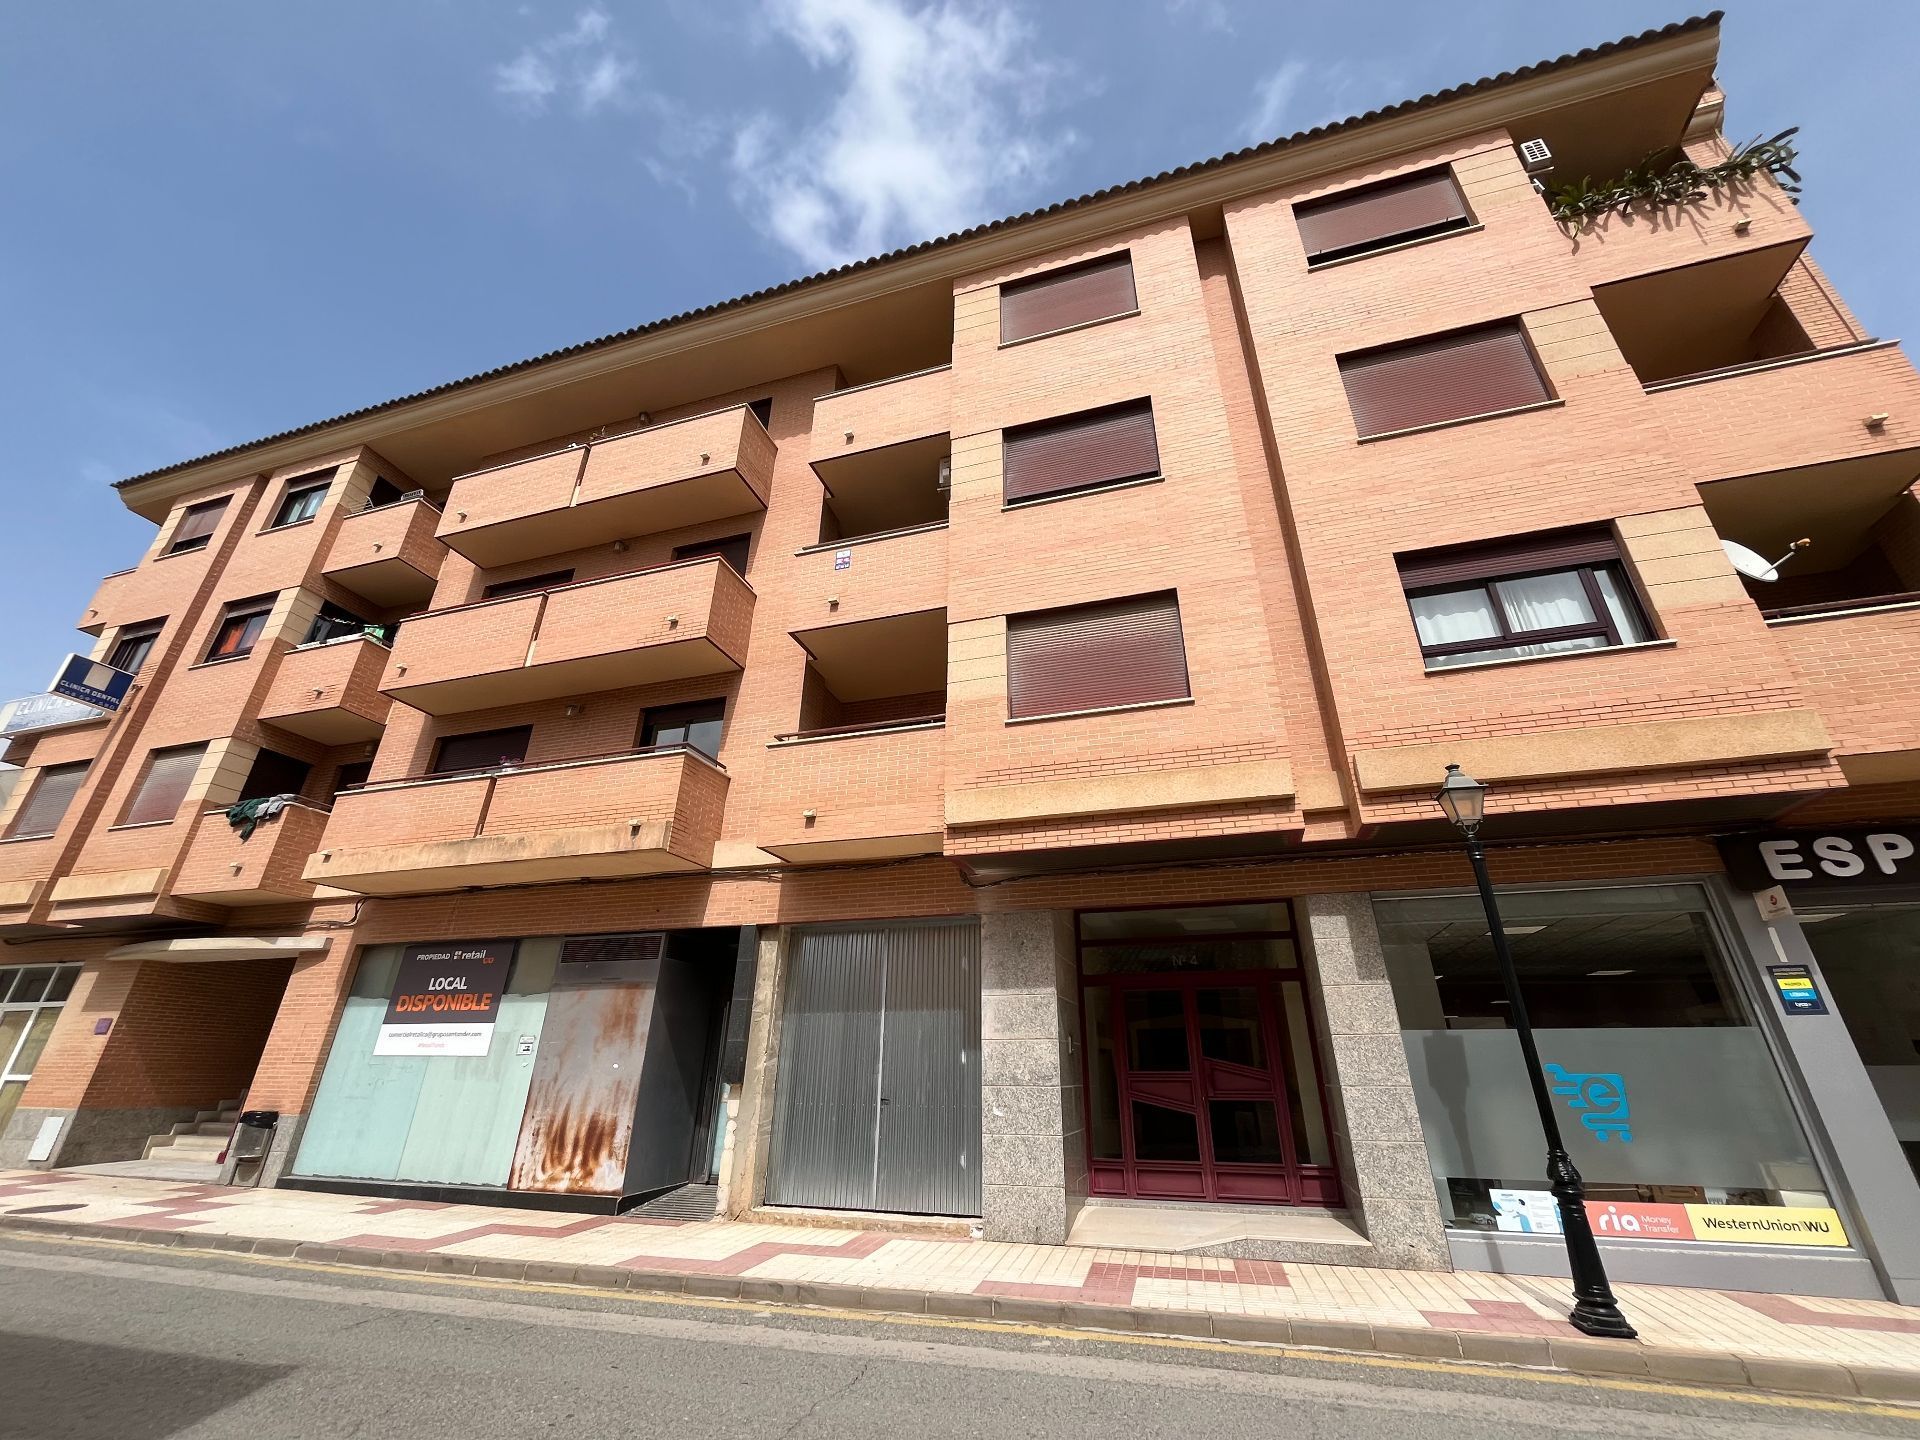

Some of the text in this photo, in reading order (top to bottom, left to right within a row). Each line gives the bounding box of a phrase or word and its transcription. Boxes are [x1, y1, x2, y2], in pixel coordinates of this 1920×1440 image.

[91, 690, 120, 704] DENTAL
[1759, 833, 1914, 879] ESP
[416, 949, 487, 961] PROPIEDAD retail
[428, 976, 468, 991] LOCAL
[396, 993, 493, 1012] DISPONIBLE
[1598, 1205, 1671, 1232] ria Money
[1643, 1224, 1679, 1234] Transfer
[1804, 1221, 1830, 1233] WU
